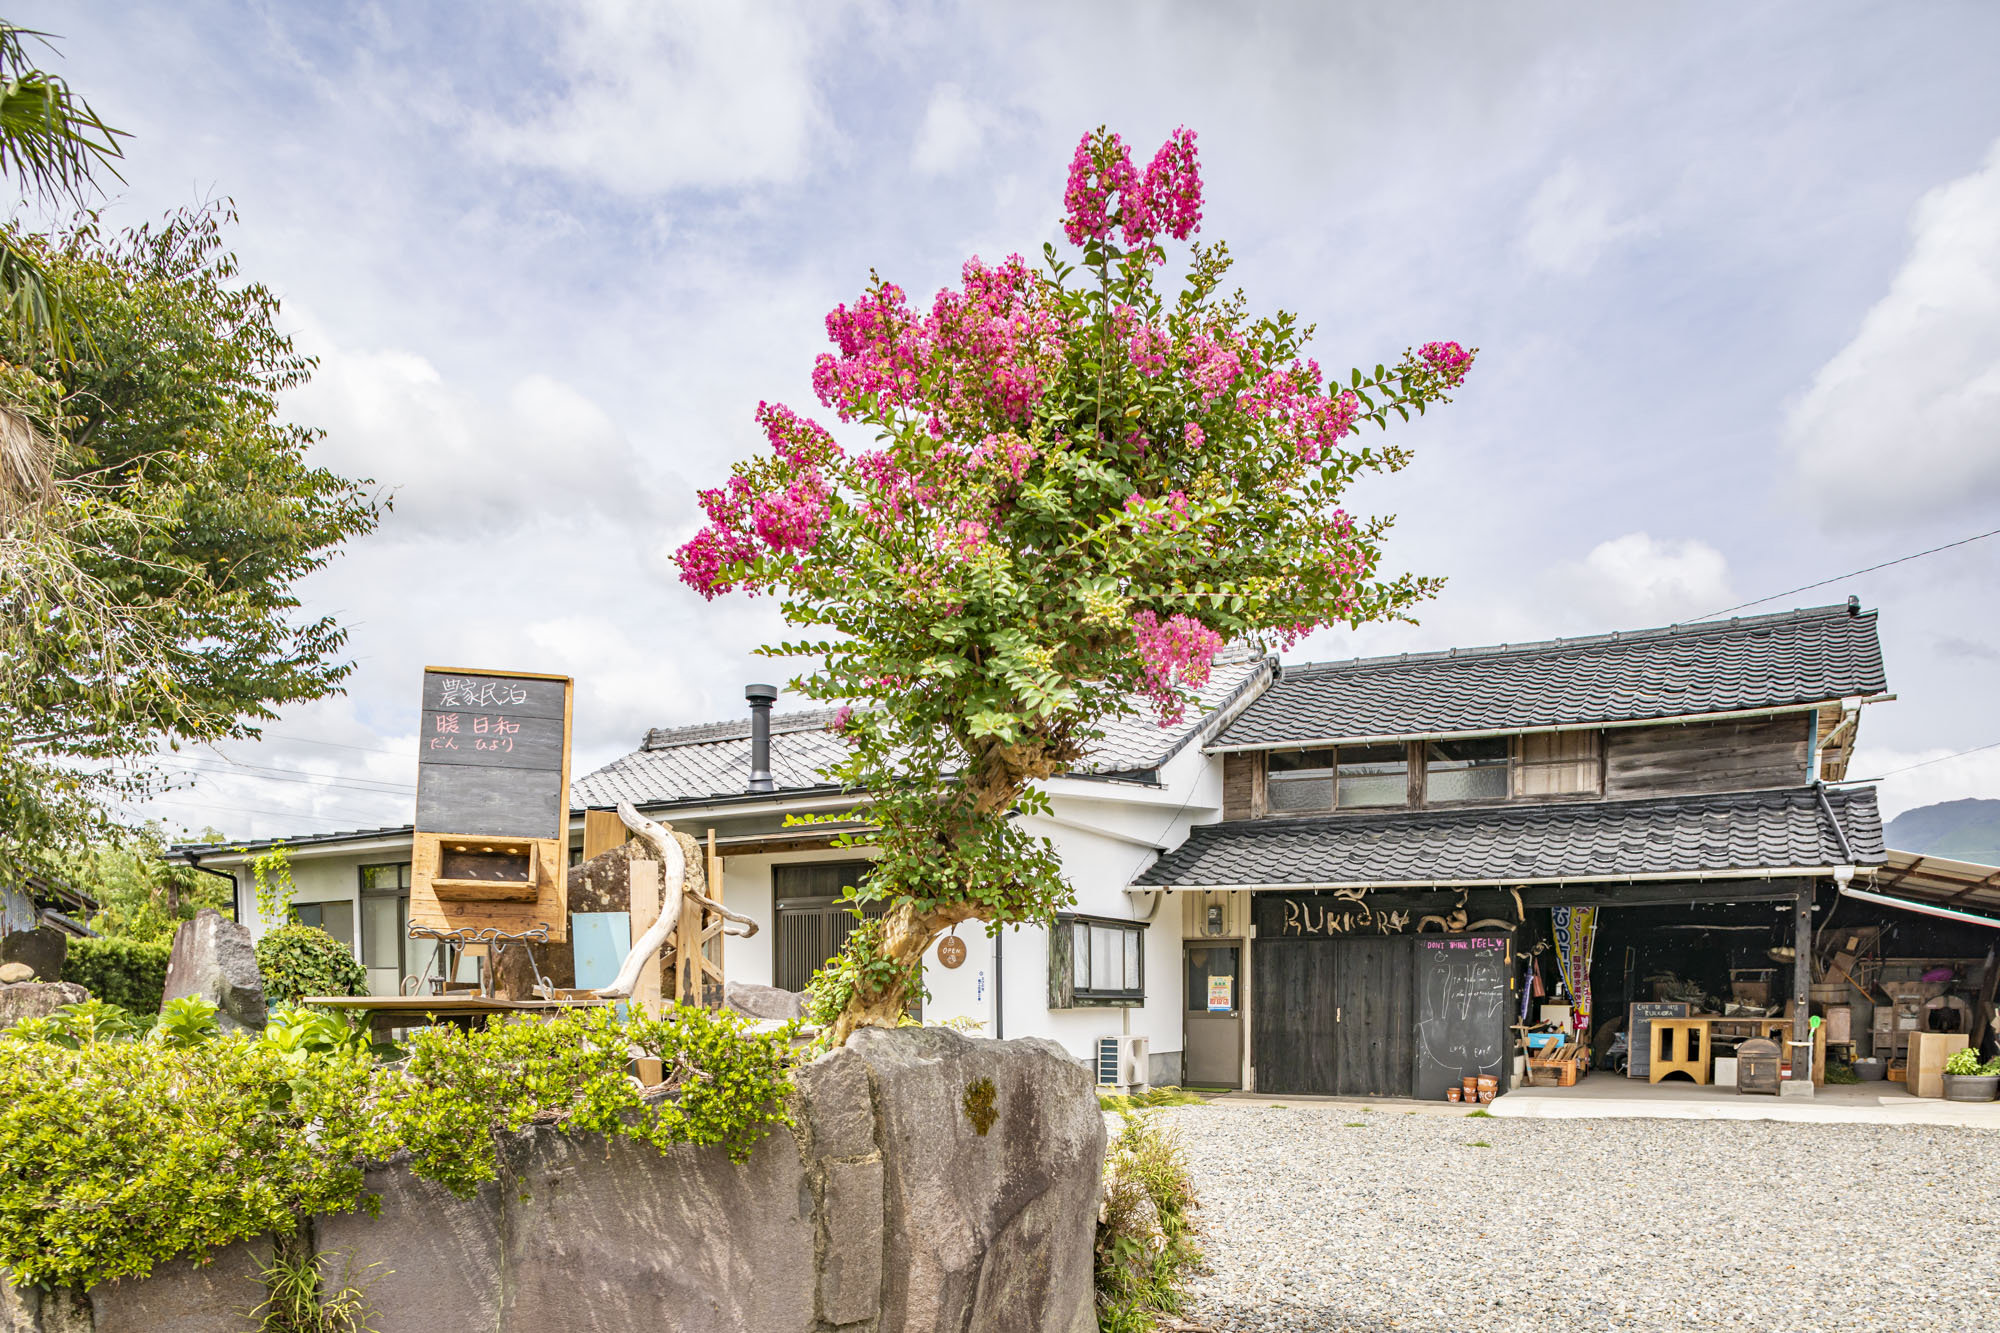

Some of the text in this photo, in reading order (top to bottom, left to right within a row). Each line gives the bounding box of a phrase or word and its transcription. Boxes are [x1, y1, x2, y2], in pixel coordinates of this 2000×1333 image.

[440, 679, 526, 707] 農家民泊
[436, 713, 520, 735] 暖 日和
[475, 737, 513, 752] ひより
